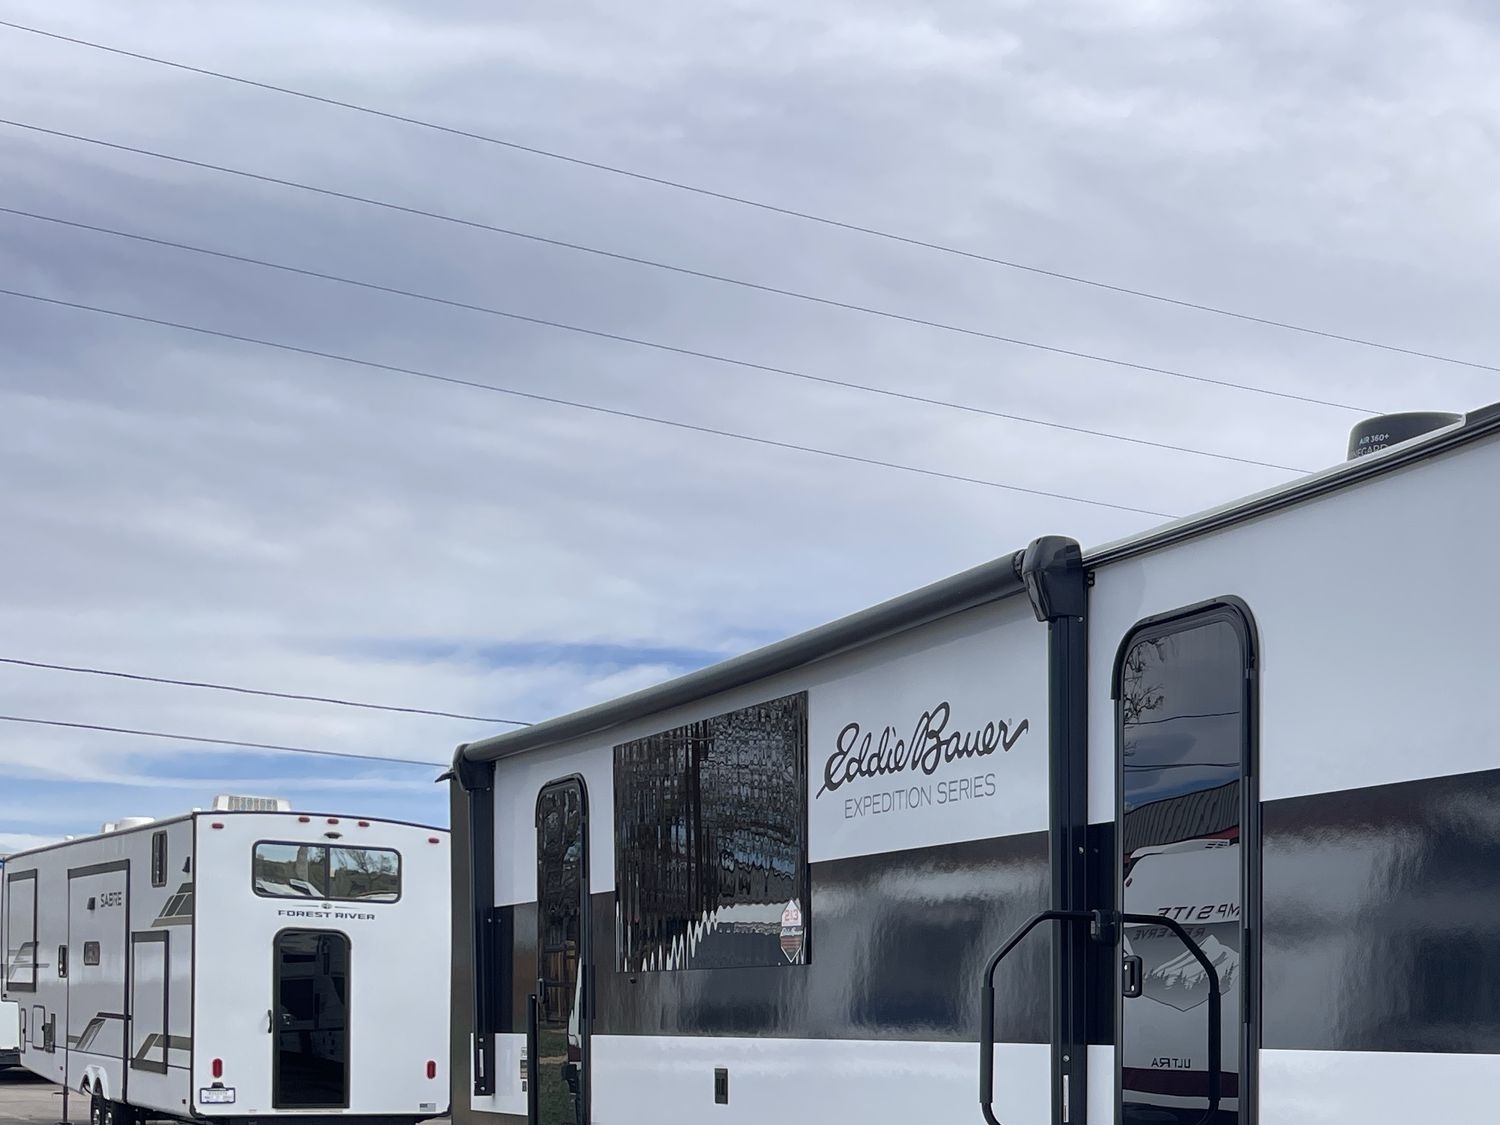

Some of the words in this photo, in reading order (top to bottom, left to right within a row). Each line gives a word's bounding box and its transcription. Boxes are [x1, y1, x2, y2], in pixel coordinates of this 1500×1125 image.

[816, 722, 906, 800] Eddie
[908, 701, 1029, 776] Bauer
[844, 784, 932, 819] EXPEDITION
[936, 773, 996, 805] SERIES
[100, 891, 122, 908] SABRE
[278, 909, 332, 919] FOREST
[335, 912, 376, 921] RIVER
